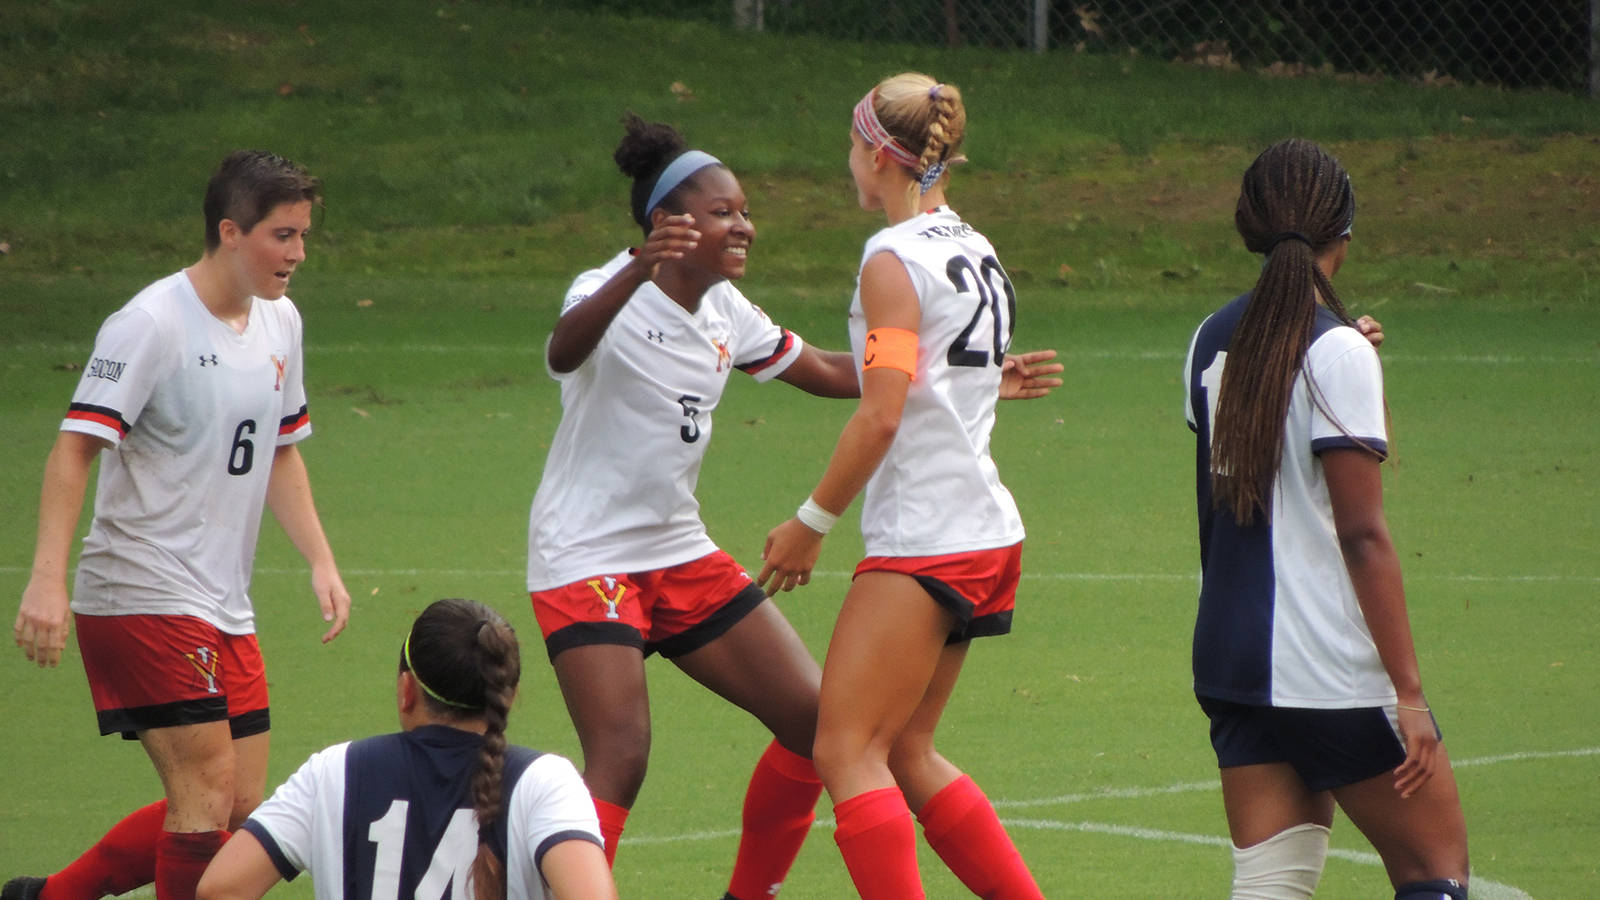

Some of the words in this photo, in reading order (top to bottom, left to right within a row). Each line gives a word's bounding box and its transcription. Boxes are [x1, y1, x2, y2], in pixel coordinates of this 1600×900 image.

[946, 255, 1016, 367] 20
[88, 357, 127, 382] SOCON
[864, 334, 877, 366] C
[678, 394, 701, 443] 5
[228, 419, 256, 475] 6
[368, 799, 480, 900] 14
